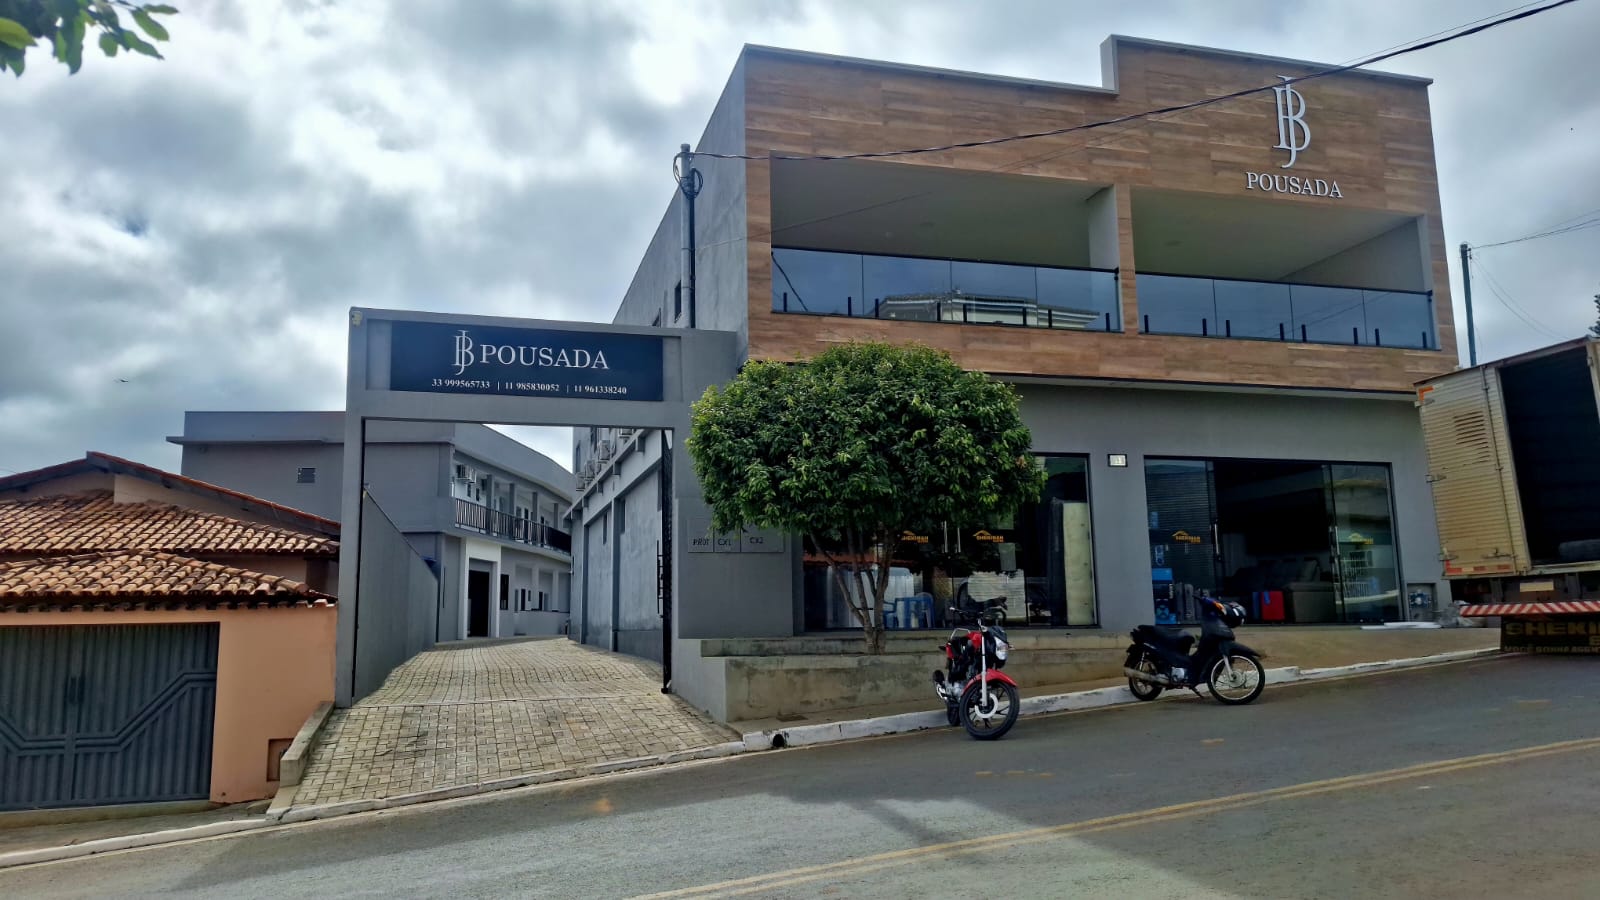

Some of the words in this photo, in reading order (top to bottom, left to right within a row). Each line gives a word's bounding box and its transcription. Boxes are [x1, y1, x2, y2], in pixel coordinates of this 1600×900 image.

[1246, 171, 1343, 198] POUSADA
[480, 344, 610, 369] POUSADA
[432, 378, 442, 387] 33
[444, 379, 490, 388] 999565733
[505, 381, 513, 390] 11
[516, 382, 560, 392] 985830052
[574, 384, 582, 392] 11
[584, 385, 627, 394] 961338240
[1505, 621, 1600, 635] SHEKI
